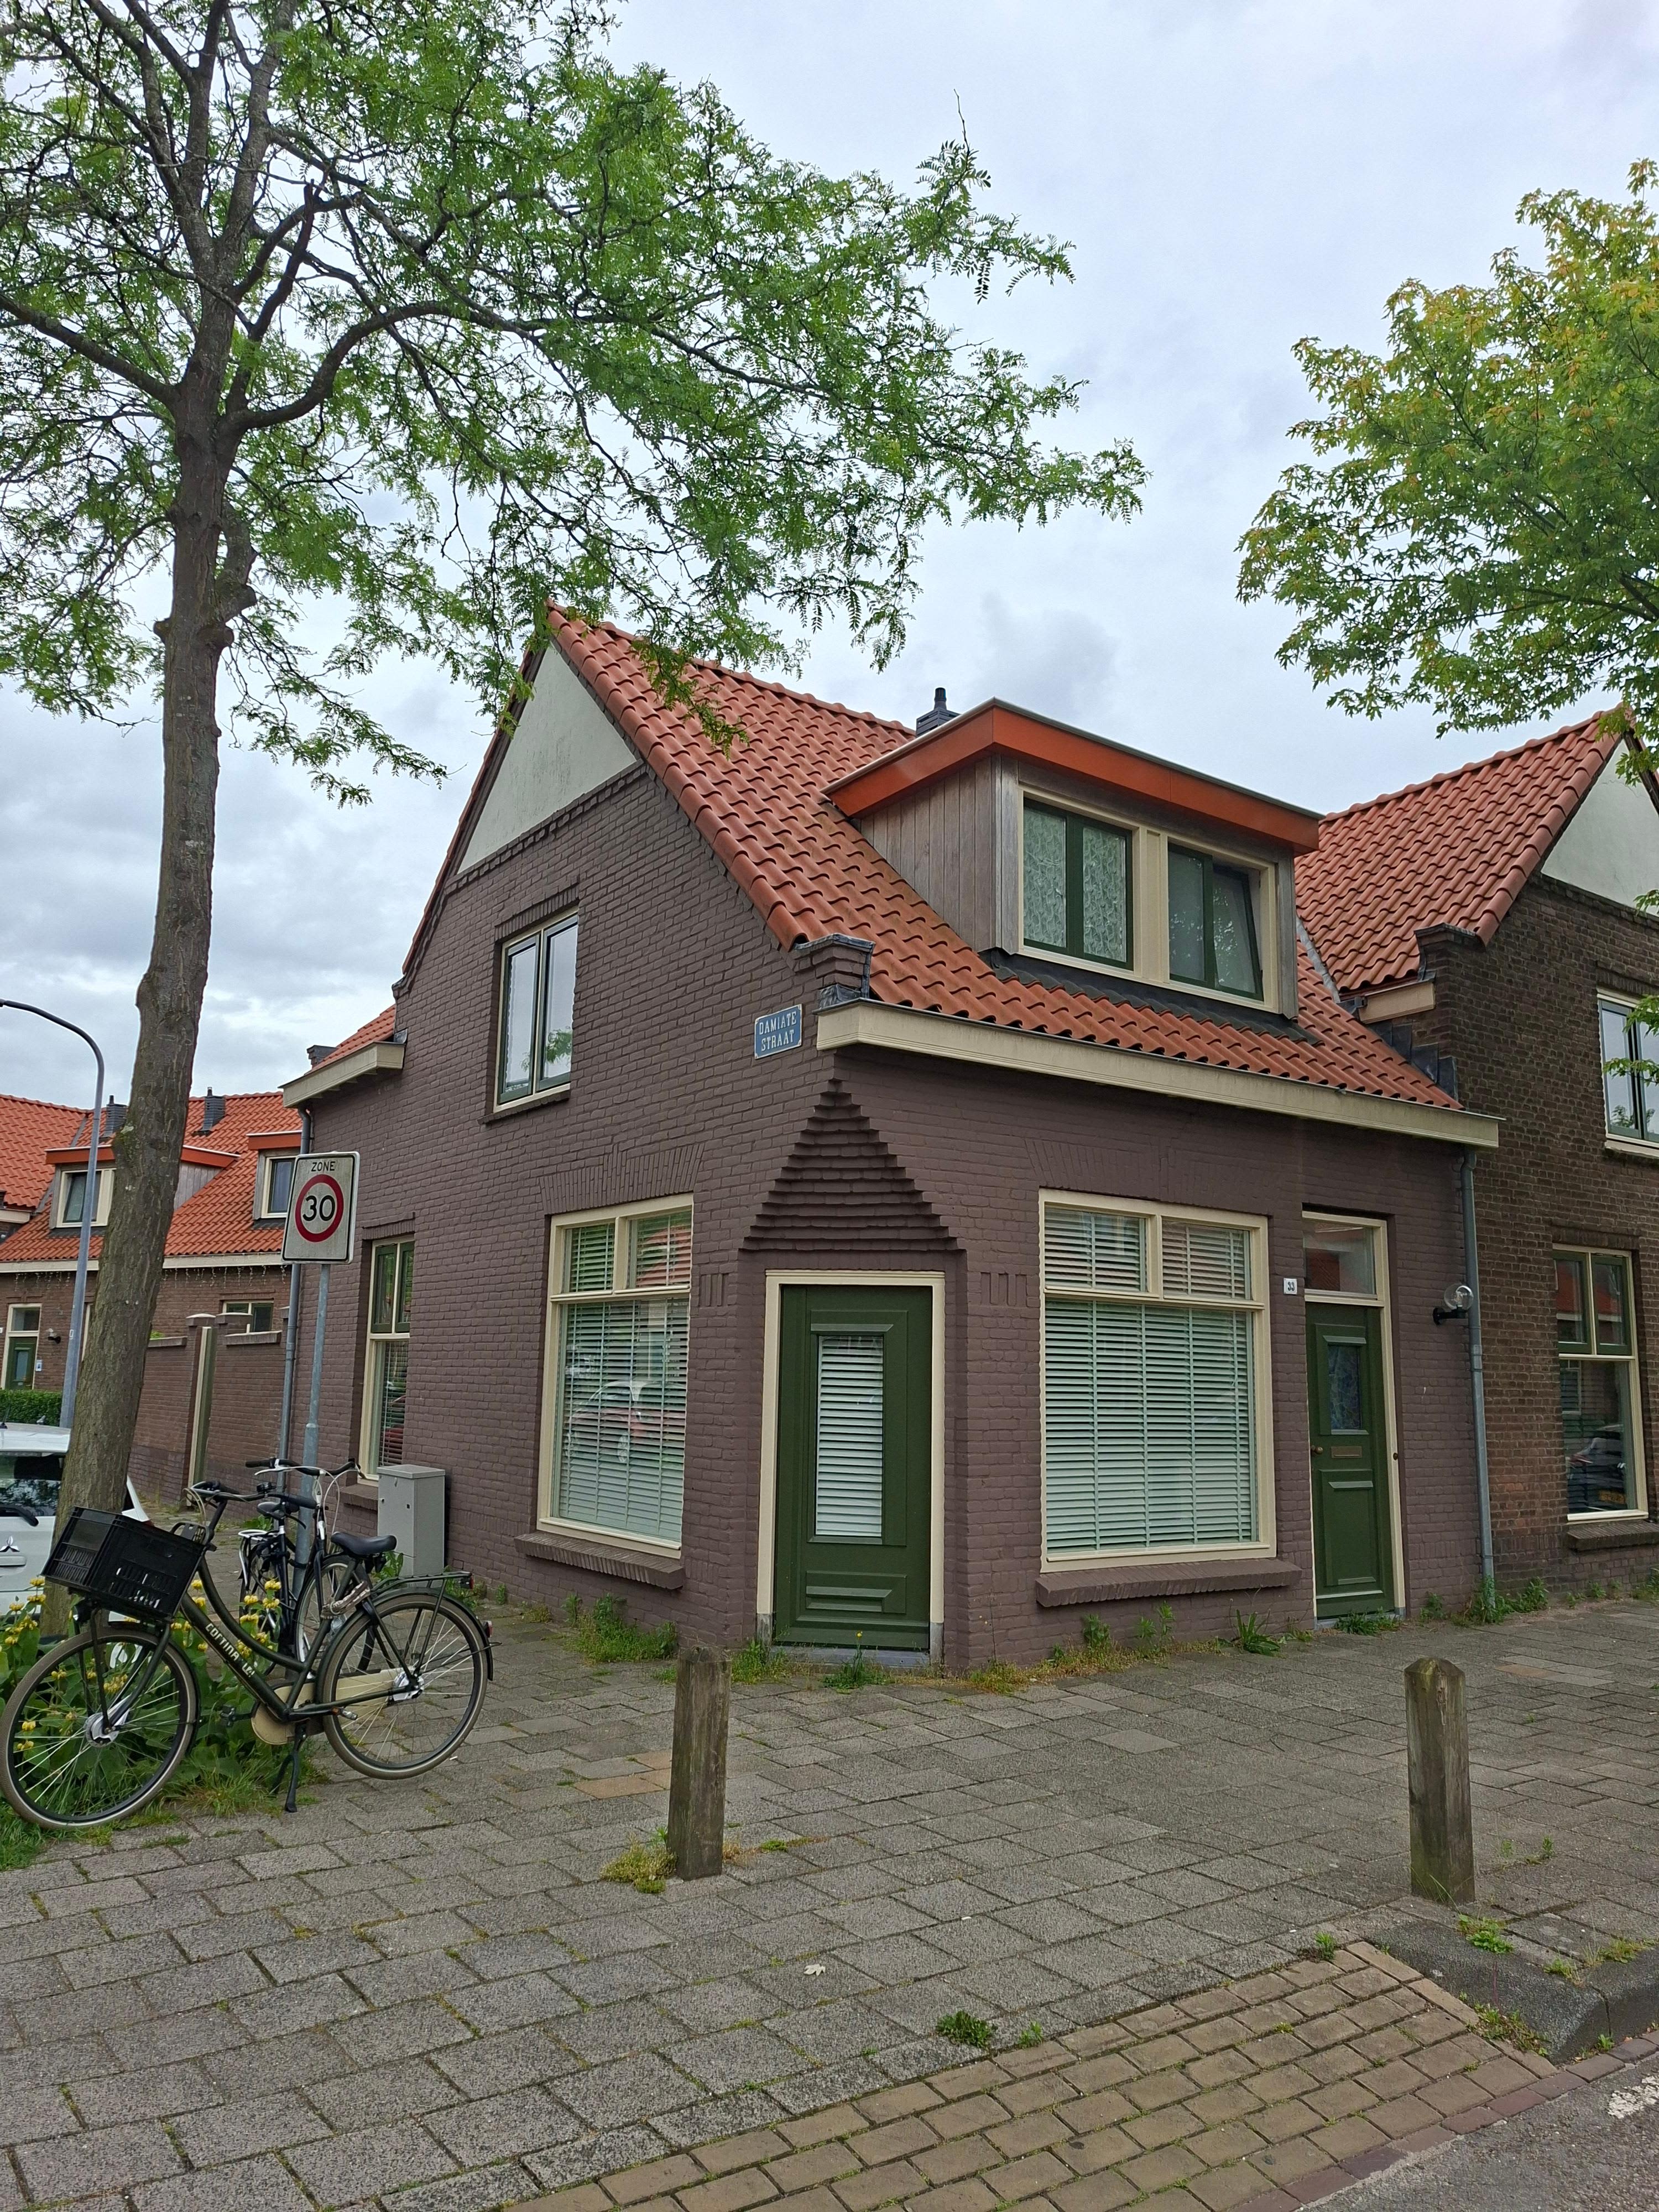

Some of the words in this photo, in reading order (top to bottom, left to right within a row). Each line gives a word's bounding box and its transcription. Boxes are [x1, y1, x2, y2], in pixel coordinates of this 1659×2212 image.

[759, 1011, 797, 1035] DAMIATE
[761, 1029, 795, 1052] STRAAT
[311, 1161, 336, 1172] ZONE
[302, 1194, 336, 1222] 30
[1287, 1281, 1295, 1291] 33
[205, 1623, 239, 1661] CORTINA
